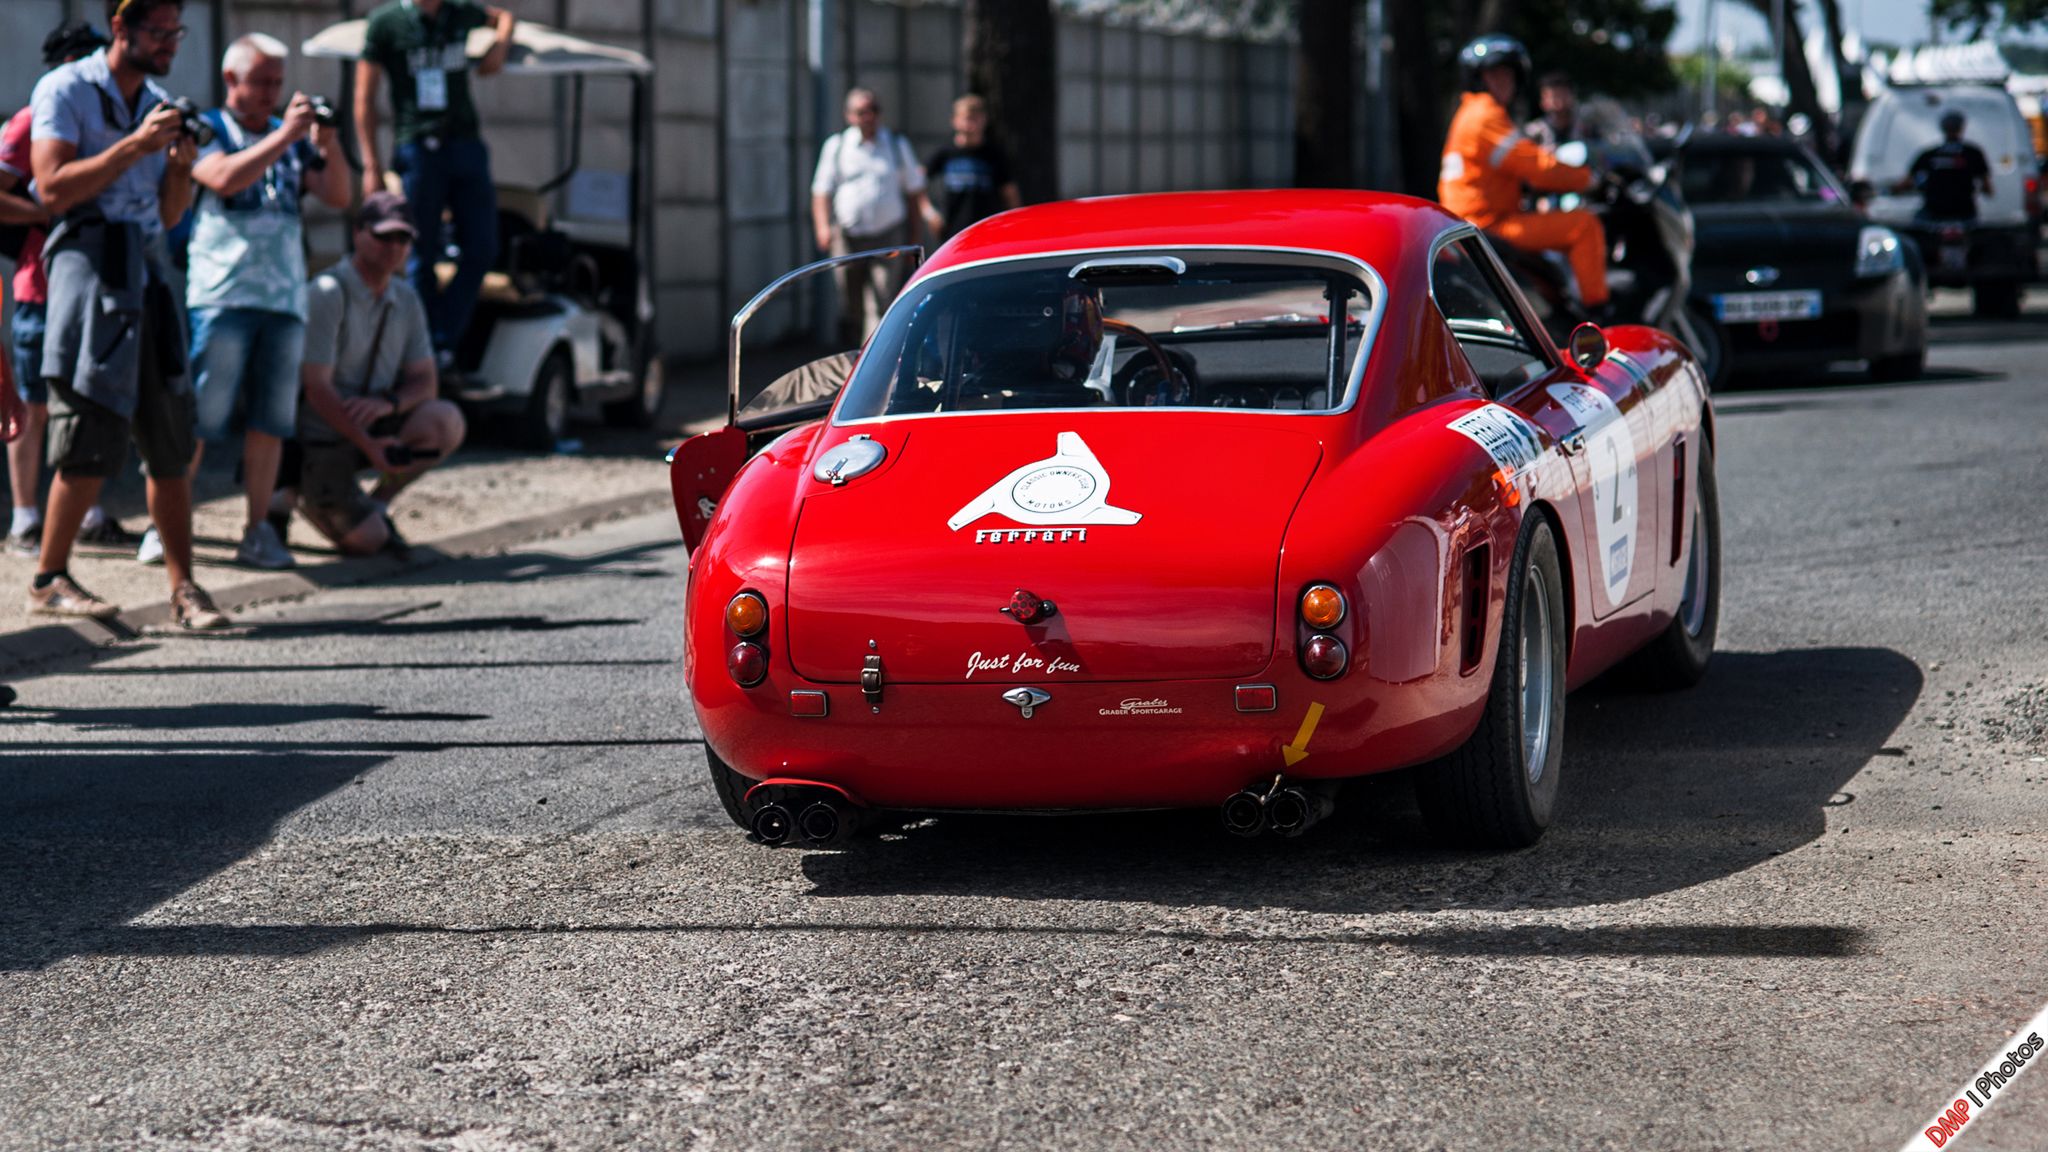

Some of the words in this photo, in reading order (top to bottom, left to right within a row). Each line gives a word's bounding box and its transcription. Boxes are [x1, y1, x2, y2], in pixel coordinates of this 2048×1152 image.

[1020, 472, 1048, 491] CLASSIC
[1049, 470, 1082, 480] OWNERS
[1606, 435, 1623, 525] 2
[1027, 499, 1073, 510] MOTORS
[975, 528, 1087, 544] Ferrari
[965, 651, 1010, 680] Just
[1011, 652, 1044, 674] for
[1046, 656, 1081, 675] fun
[1099, 708, 1129, 716] GRABER
[1131, 706, 1183, 716] SPORTGARAGE
[1120, 697, 1168, 710] Graber
